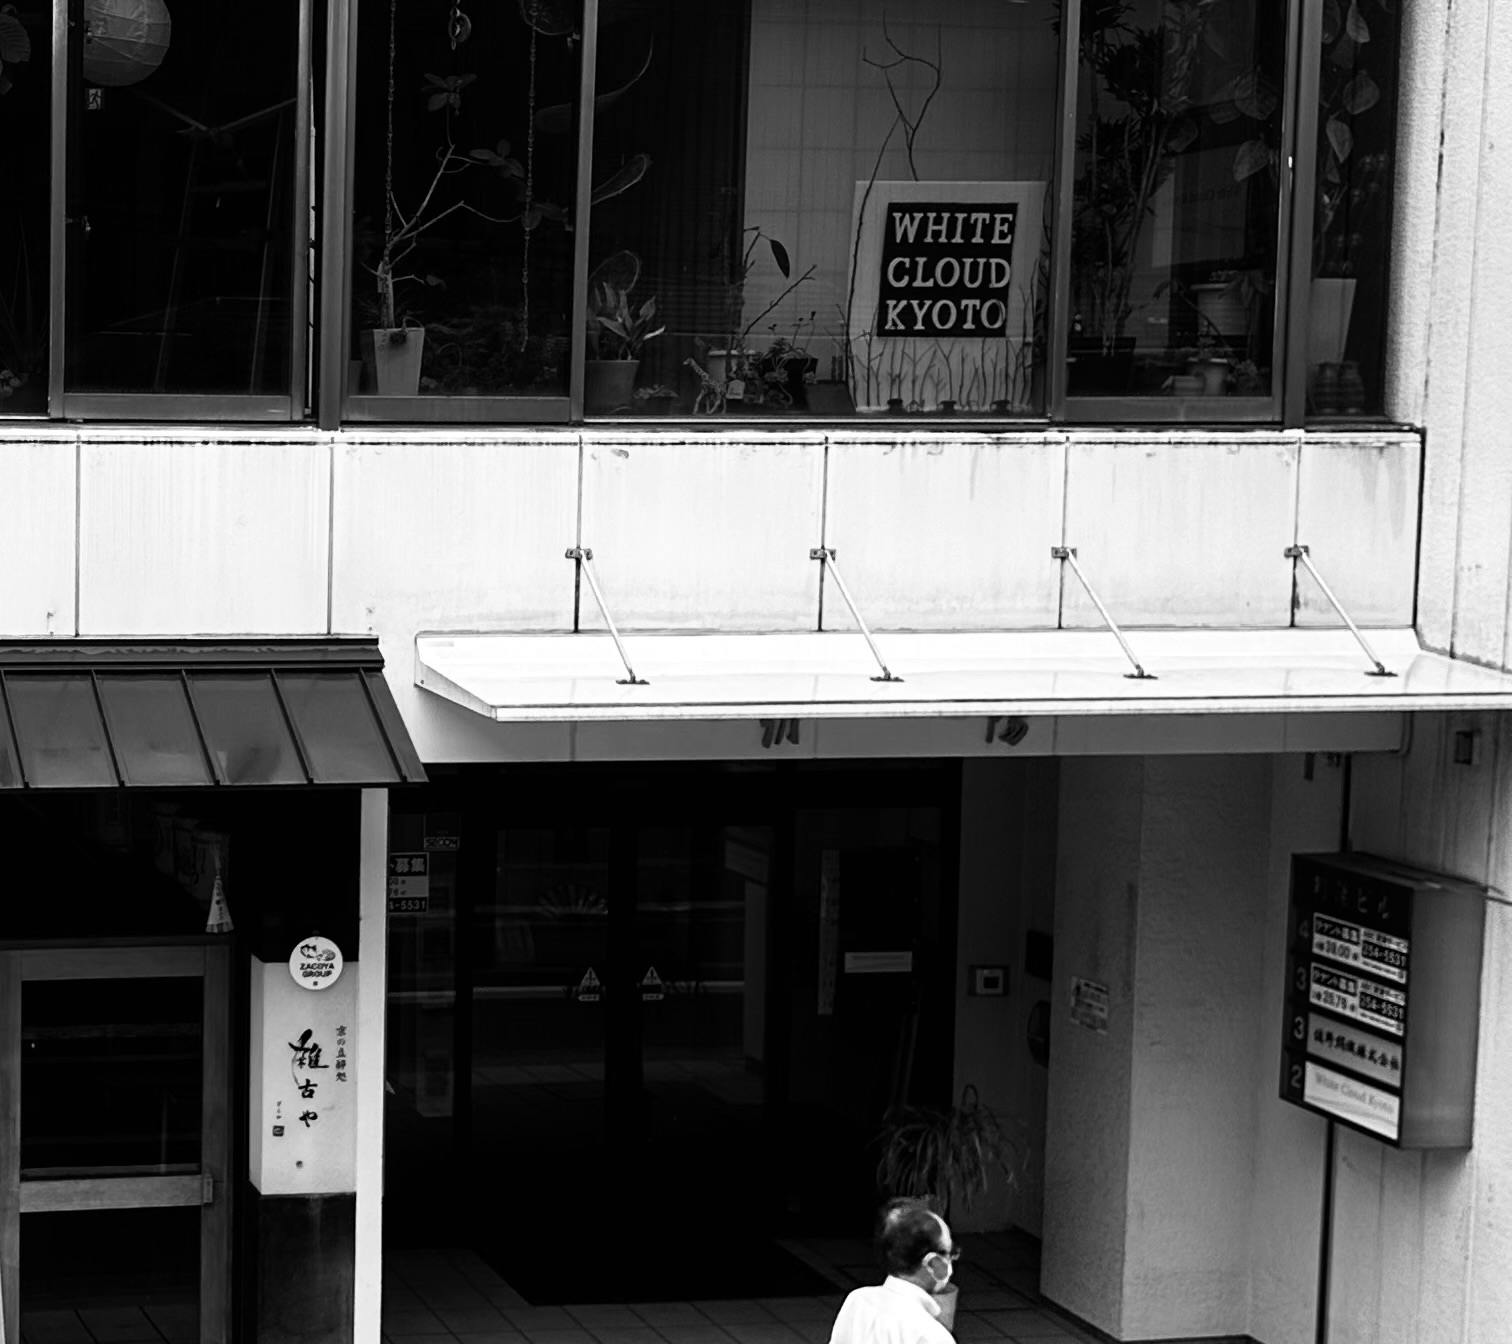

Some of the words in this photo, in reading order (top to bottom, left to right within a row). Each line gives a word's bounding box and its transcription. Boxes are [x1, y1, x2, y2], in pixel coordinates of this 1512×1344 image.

[891, 212, 1014, 244] WHITE
[886, 256, 1011, 288] CLOUD
[884, 299, 1007, 330] KYOTO
[1297, 967, 1307, 990] 3
[1294, 1016, 1304, 1039] 3
[1291, 1065, 1302, 1089] 2
